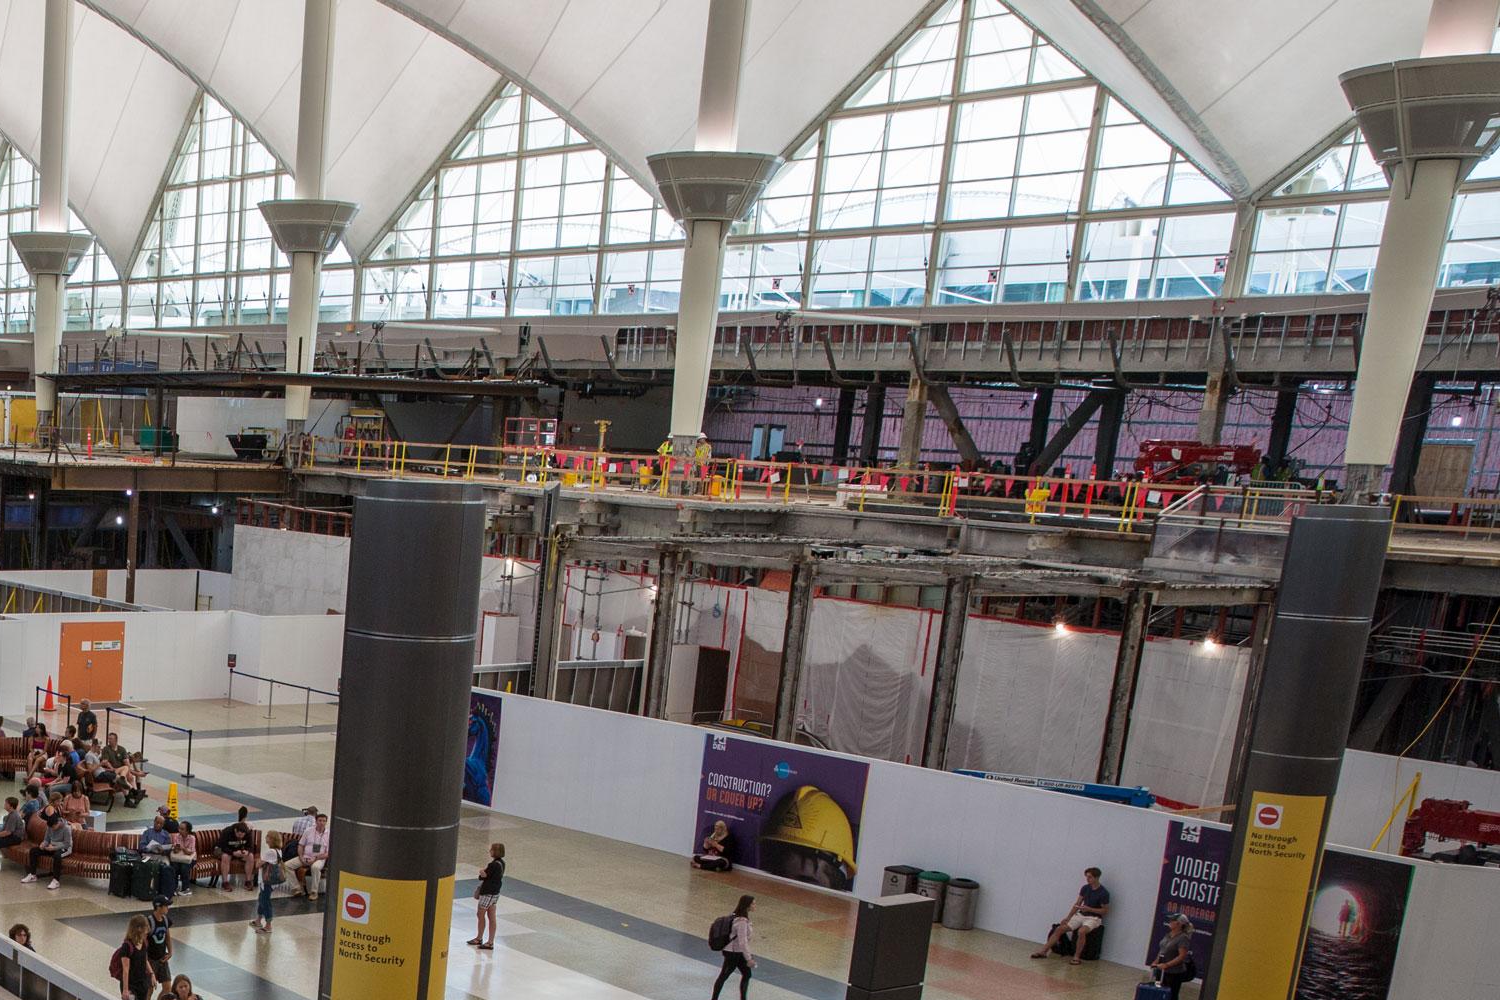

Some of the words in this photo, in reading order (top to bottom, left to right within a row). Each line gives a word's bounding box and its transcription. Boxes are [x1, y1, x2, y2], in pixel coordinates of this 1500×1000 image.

[712, 743, 727, 751] DEN
[707, 772, 772, 798] CONSTRUCTION?
[706, 788, 717, 801] OR
[719, 790, 746, 807] COVER
[747, 795, 765, 812] UP?
[1180, 834, 1200, 844] DEN
[1251, 832, 1263, 841] No
[1264, 833, 1297, 844] through
[1250, 841, 1275, 850] access
[1248, 848, 1272, 857] North
[1273, 850, 1306, 860] Security
[1174, 855, 1220, 882] UNDER
[340, 927, 351, 938] No
[353, 930, 391, 945] through
[339, 940, 365, 951] access
[367, 944, 378, 953] to
[338, 948, 362, 961] North
[365, 953, 405, 968] Security
